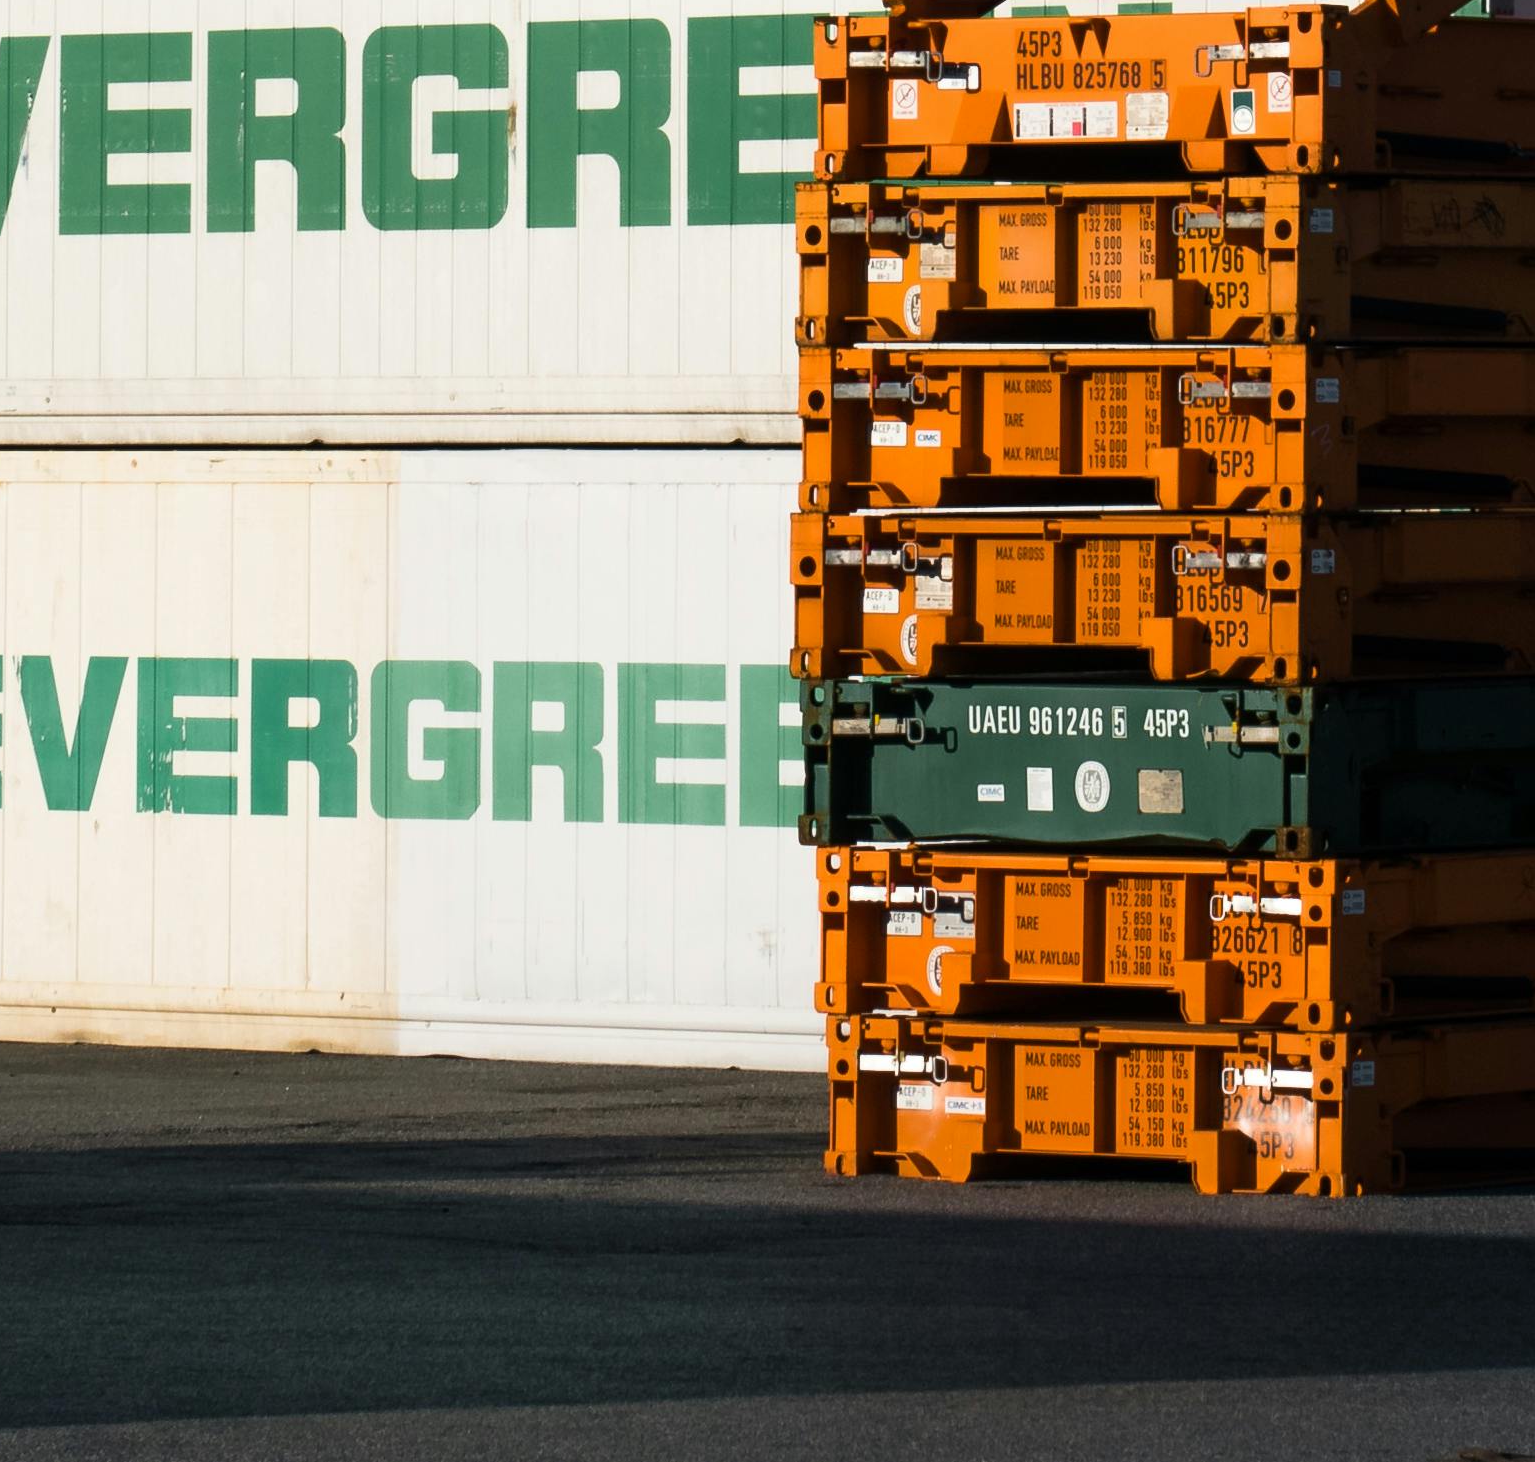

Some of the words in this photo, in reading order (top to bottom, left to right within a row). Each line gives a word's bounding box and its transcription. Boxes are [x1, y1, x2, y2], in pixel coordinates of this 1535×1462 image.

[1017, 31, 1061, 57] 45P3
[1017, 63, 1064, 89] HLBU
[1074, 62, 1141, 89] 825768
[1154, 60, 1163, 88] 5
[999, 214, 1018, 227] MAX.
[1021, 213, 1047, 227] GROSS
[999, 247, 1019, 260] TARE
[1177, 247, 1244, 273] 811796
[999, 281, 1018, 294] MAX.
[1021, 281, 1055, 294] PAYLOAD
[1207, 283, 1249, 309] 45P3
[1183, 416, 1250, 442] 816777
[918, 434, 938, 442] CIMC
[1211, 451, 1254, 477] 45P3
[1176, 585, 1243, 612] 816569
[1205, 621, 1248, 647] 45P3
[969, 705, 1020, 733] UAEU
[1030, 707, 1103, 735] 961246
[1115, 708, 1125, 735] 5
[1144, 709, 1189, 737] 45P3
[980, 788, 1003, 796] CIMC
[1016, 882, 1037, 896] MAX.
[1040, 884, 1071, 897] GROSS
[1111, 892, 1152, 907] 132.280
[1160, 894, 1176, 908] lbs
[1017, 917, 1039, 930] TARE
[1122, 912, 1151, 925] 5.850
[1160, 914, 1172, 929] kg
[1114, 928, 1152, 942] 12.900
[1160, 928, 1176, 942] lbs
[1211, 926, 1279, 954] 826621
[1293, 930, 1302, 952] 8
[1016, 950, 1037, 964] MAX.
[1040, 951, 1080, 965] PAYLOAD
[1114, 945, 1151, 960] 54.150
[1160, 948, 1172, 963] kg
[1110, 961, 1151, 975] 119.380
[1160, 962, 1175, 976] lbs
[1236, 962, 1281, 988] 45P3
[1026, 1052, 1046, 1066] MAX.
[1050, 1053, 1081, 1067] GROSS
[1026, 1087, 1049, 1100] TARE
[1026, 1122, 1046, 1135] MAX.
[1050, 1122, 1090, 1136] PAYLOAD
[1249, 1131, 1294, 1158] 45P3
